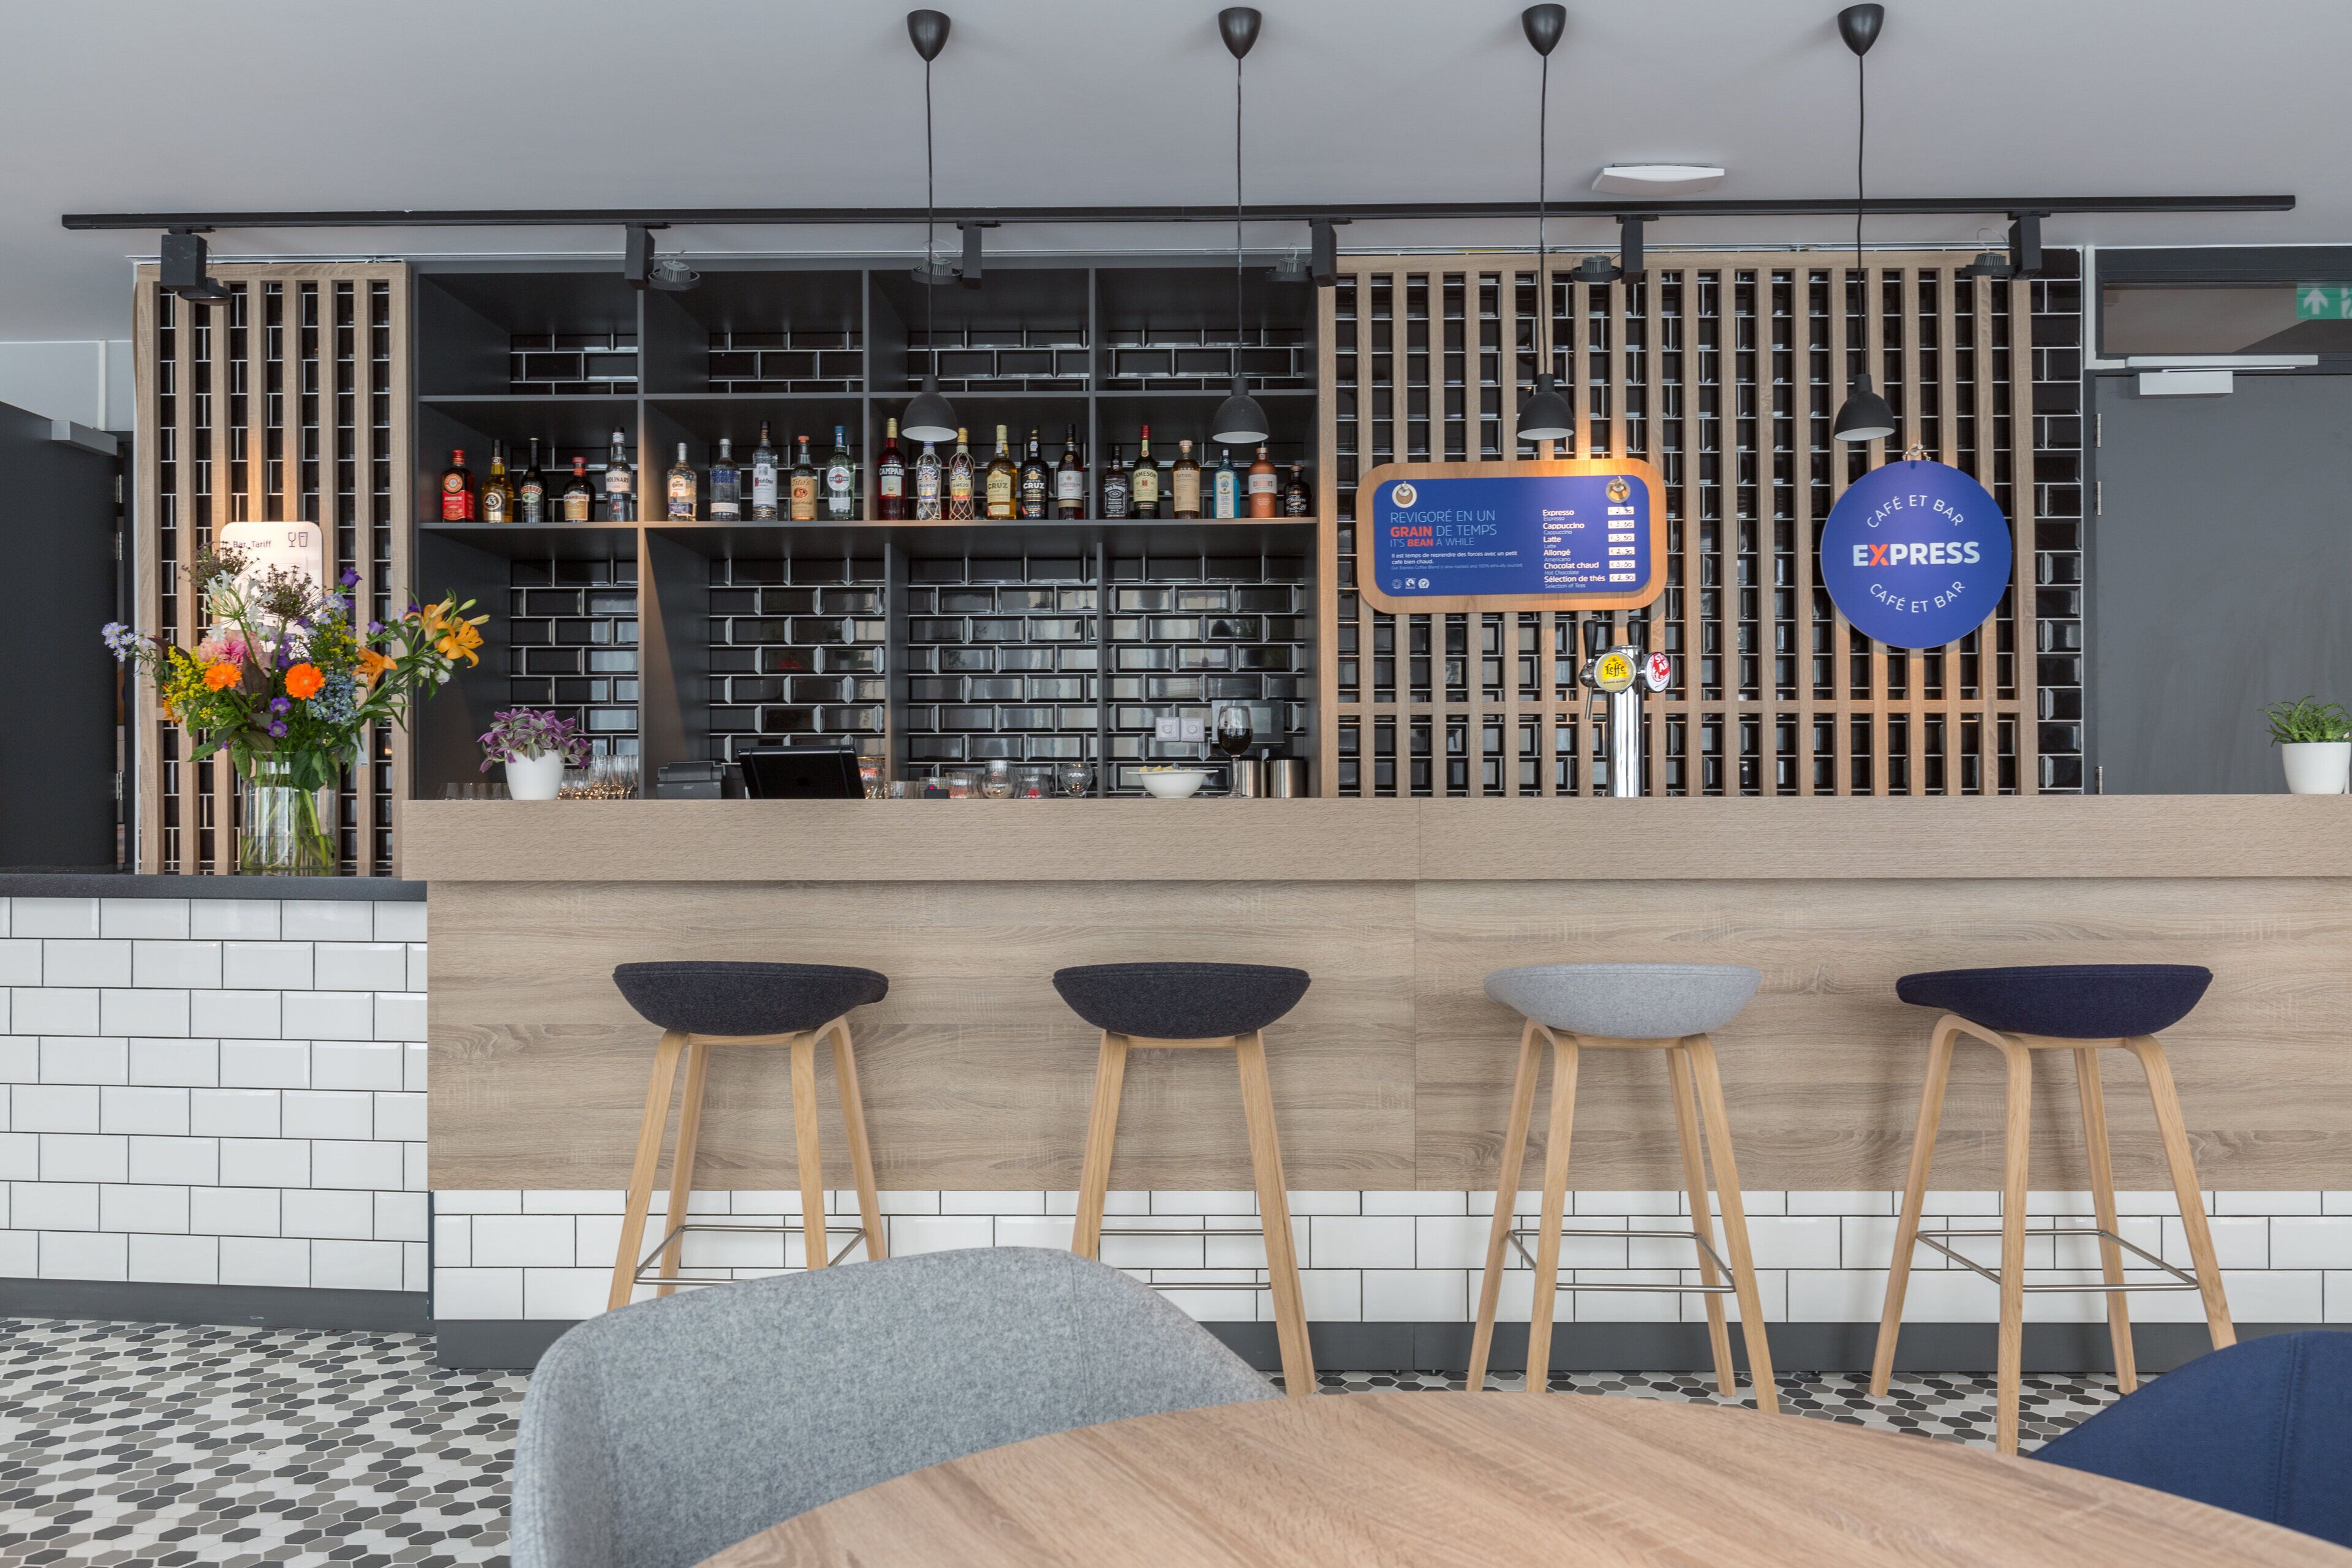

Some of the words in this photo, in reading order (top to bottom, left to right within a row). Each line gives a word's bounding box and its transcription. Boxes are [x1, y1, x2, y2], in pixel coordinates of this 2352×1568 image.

[486, 497, 497, 505] 43
[1390, 509, 1452, 523] REVIGORÉ
[1457, 511, 1472, 522] EN
[1477, 510, 1495, 521] UN
[1867, 496, 1903, 528] CAFÉ
[1909, 495, 1928, 507] ET
[1933, 499, 1964, 526] BAR
[1390, 526, 1433, 537] GRAIN
[1436, 526, 1452, 537] DE
[1456, 524, 1497, 536] TEMPS
[1407, 538, 1433, 547] BEAN
[1446, 537, 1474, 546] WHILE
[1853, 541, 1980, 567] EXPRESS
[1870, 584, 1905, 611] CAFÉ
[1911, 600, 1928, 613] ET
[1934, 581, 1966, 608] BAR
[1605, 662, 1626, 677] Leffe
